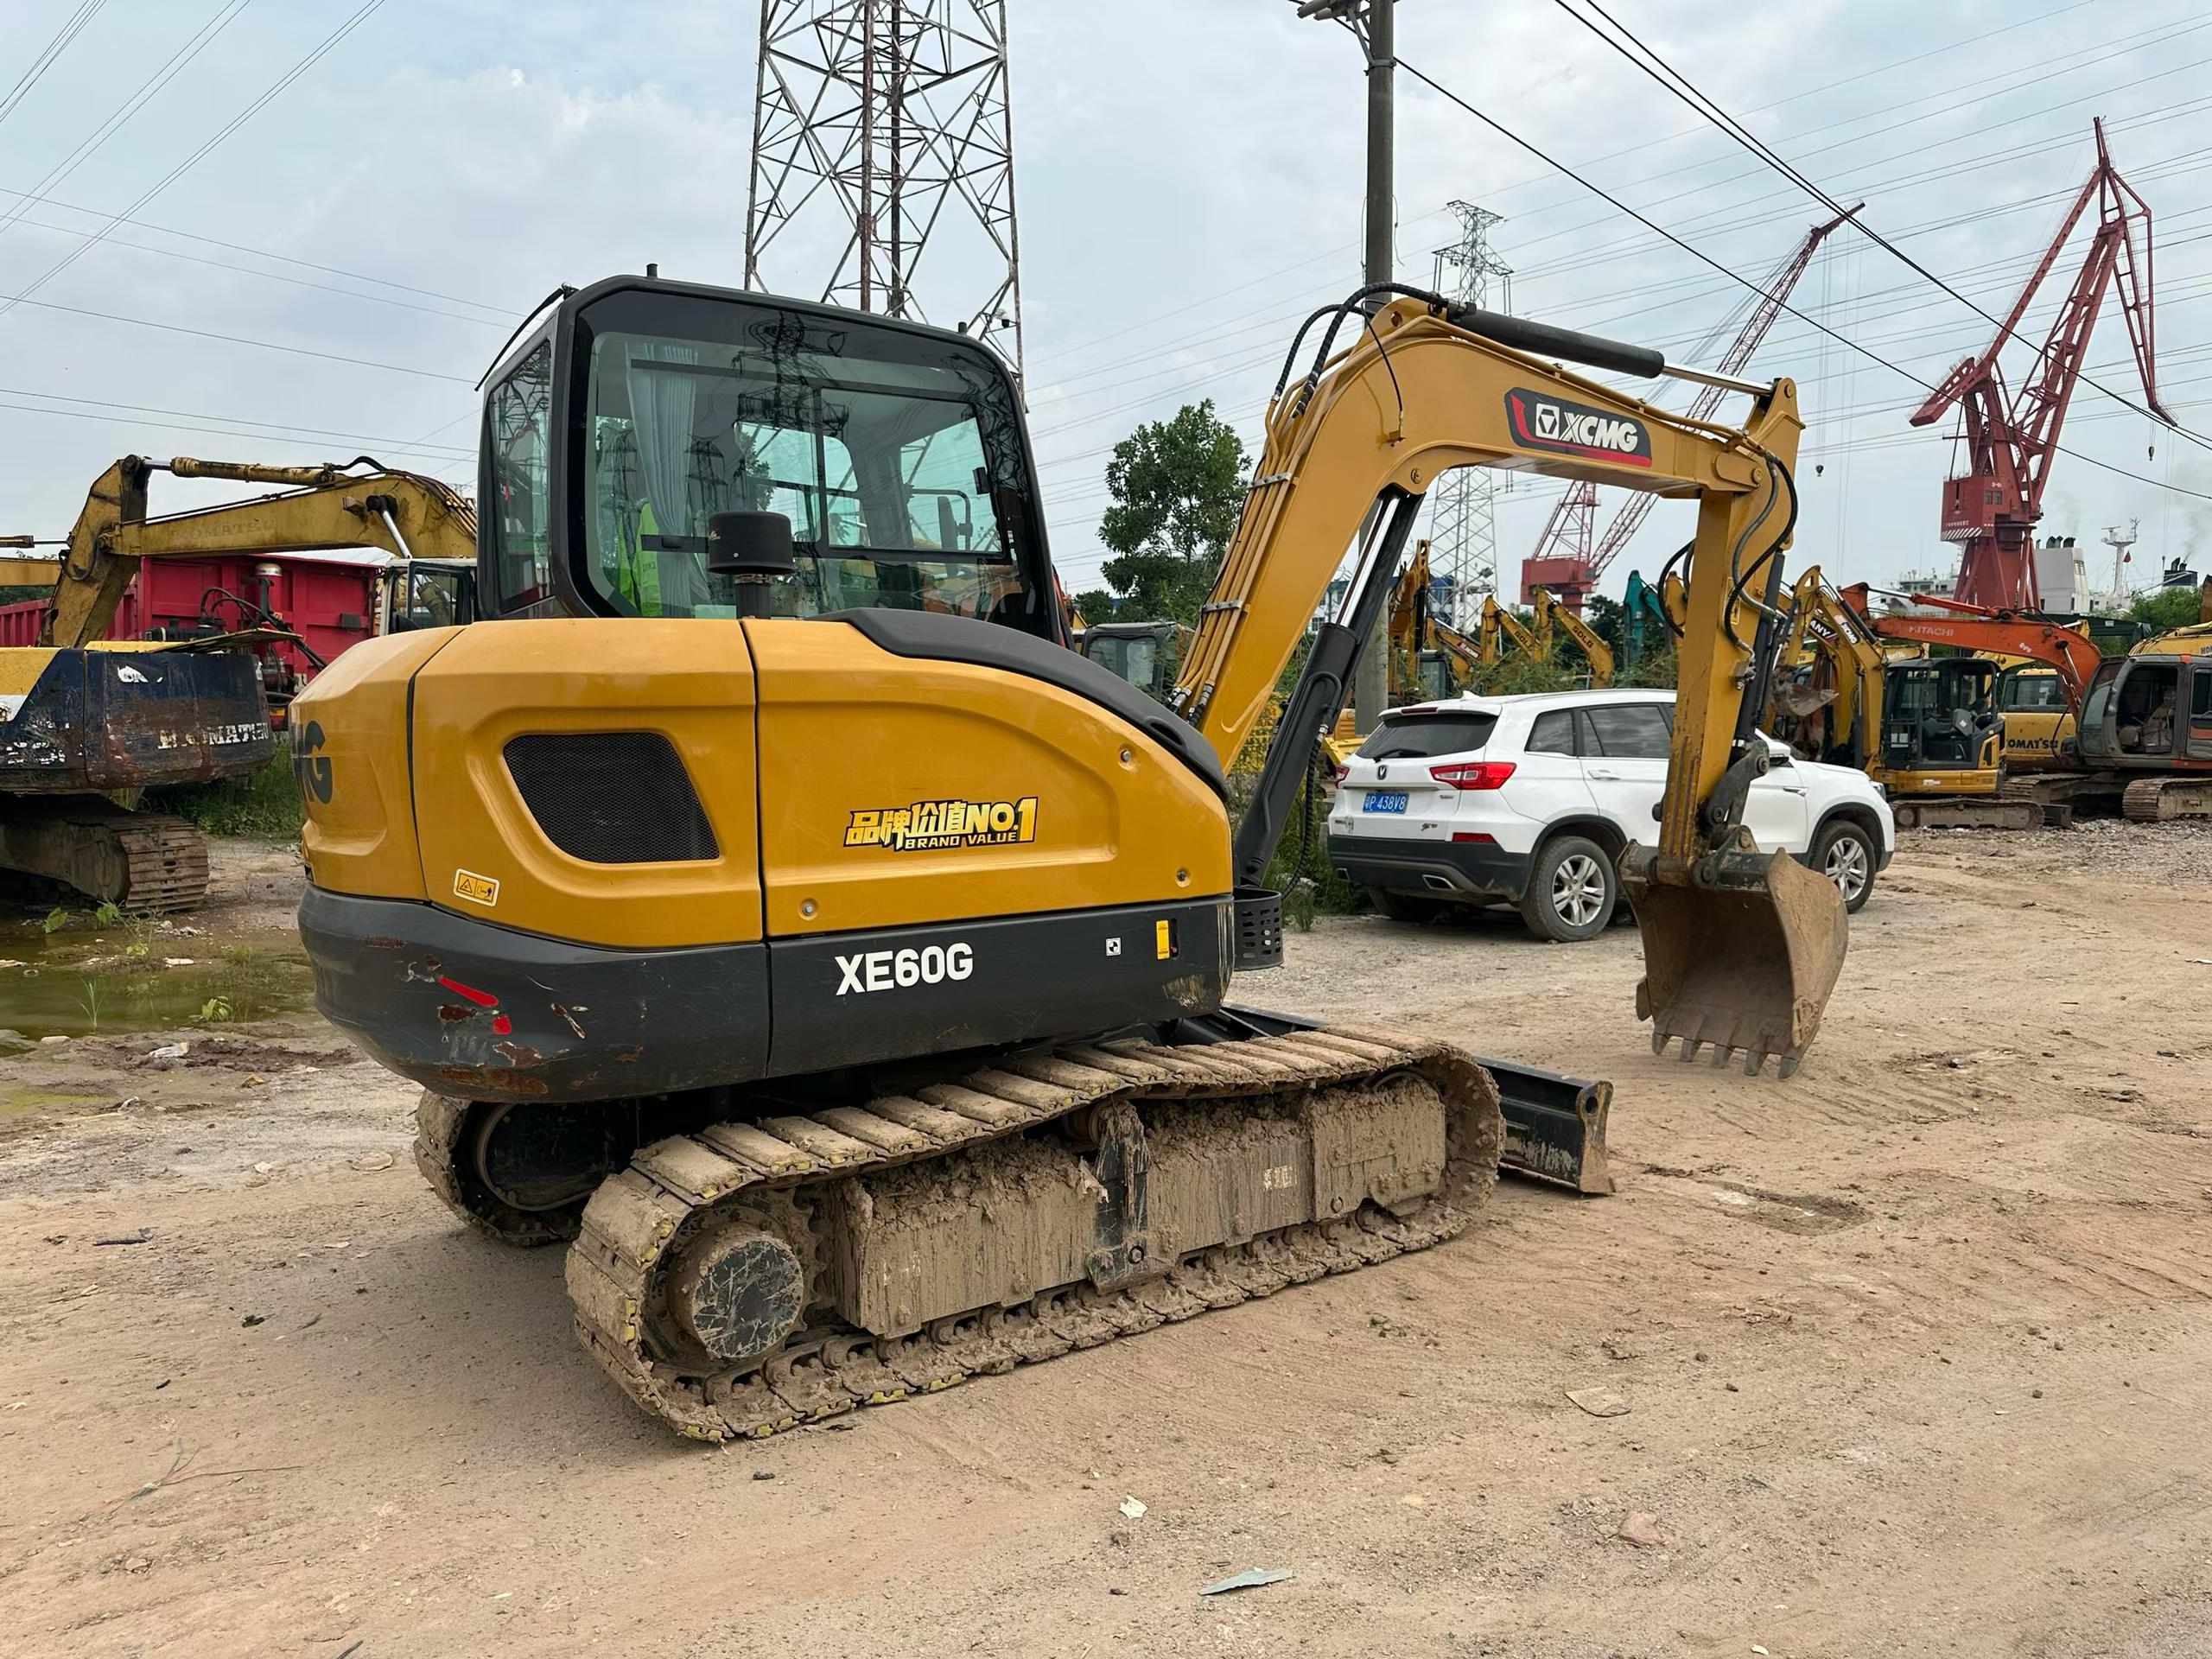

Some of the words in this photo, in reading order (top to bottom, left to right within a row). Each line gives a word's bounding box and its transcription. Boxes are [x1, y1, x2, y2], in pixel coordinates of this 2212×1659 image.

[1559, 411, 1638, 453] XCMG
[1809, 620, 1831, 637] ANY
[2008, 739, 2059, 749] OMATSU
[905, 836, 960, 849] BRAND
[967, 831, 1016, 845] VALUE
[834, 943, 974, 995] XE60G
